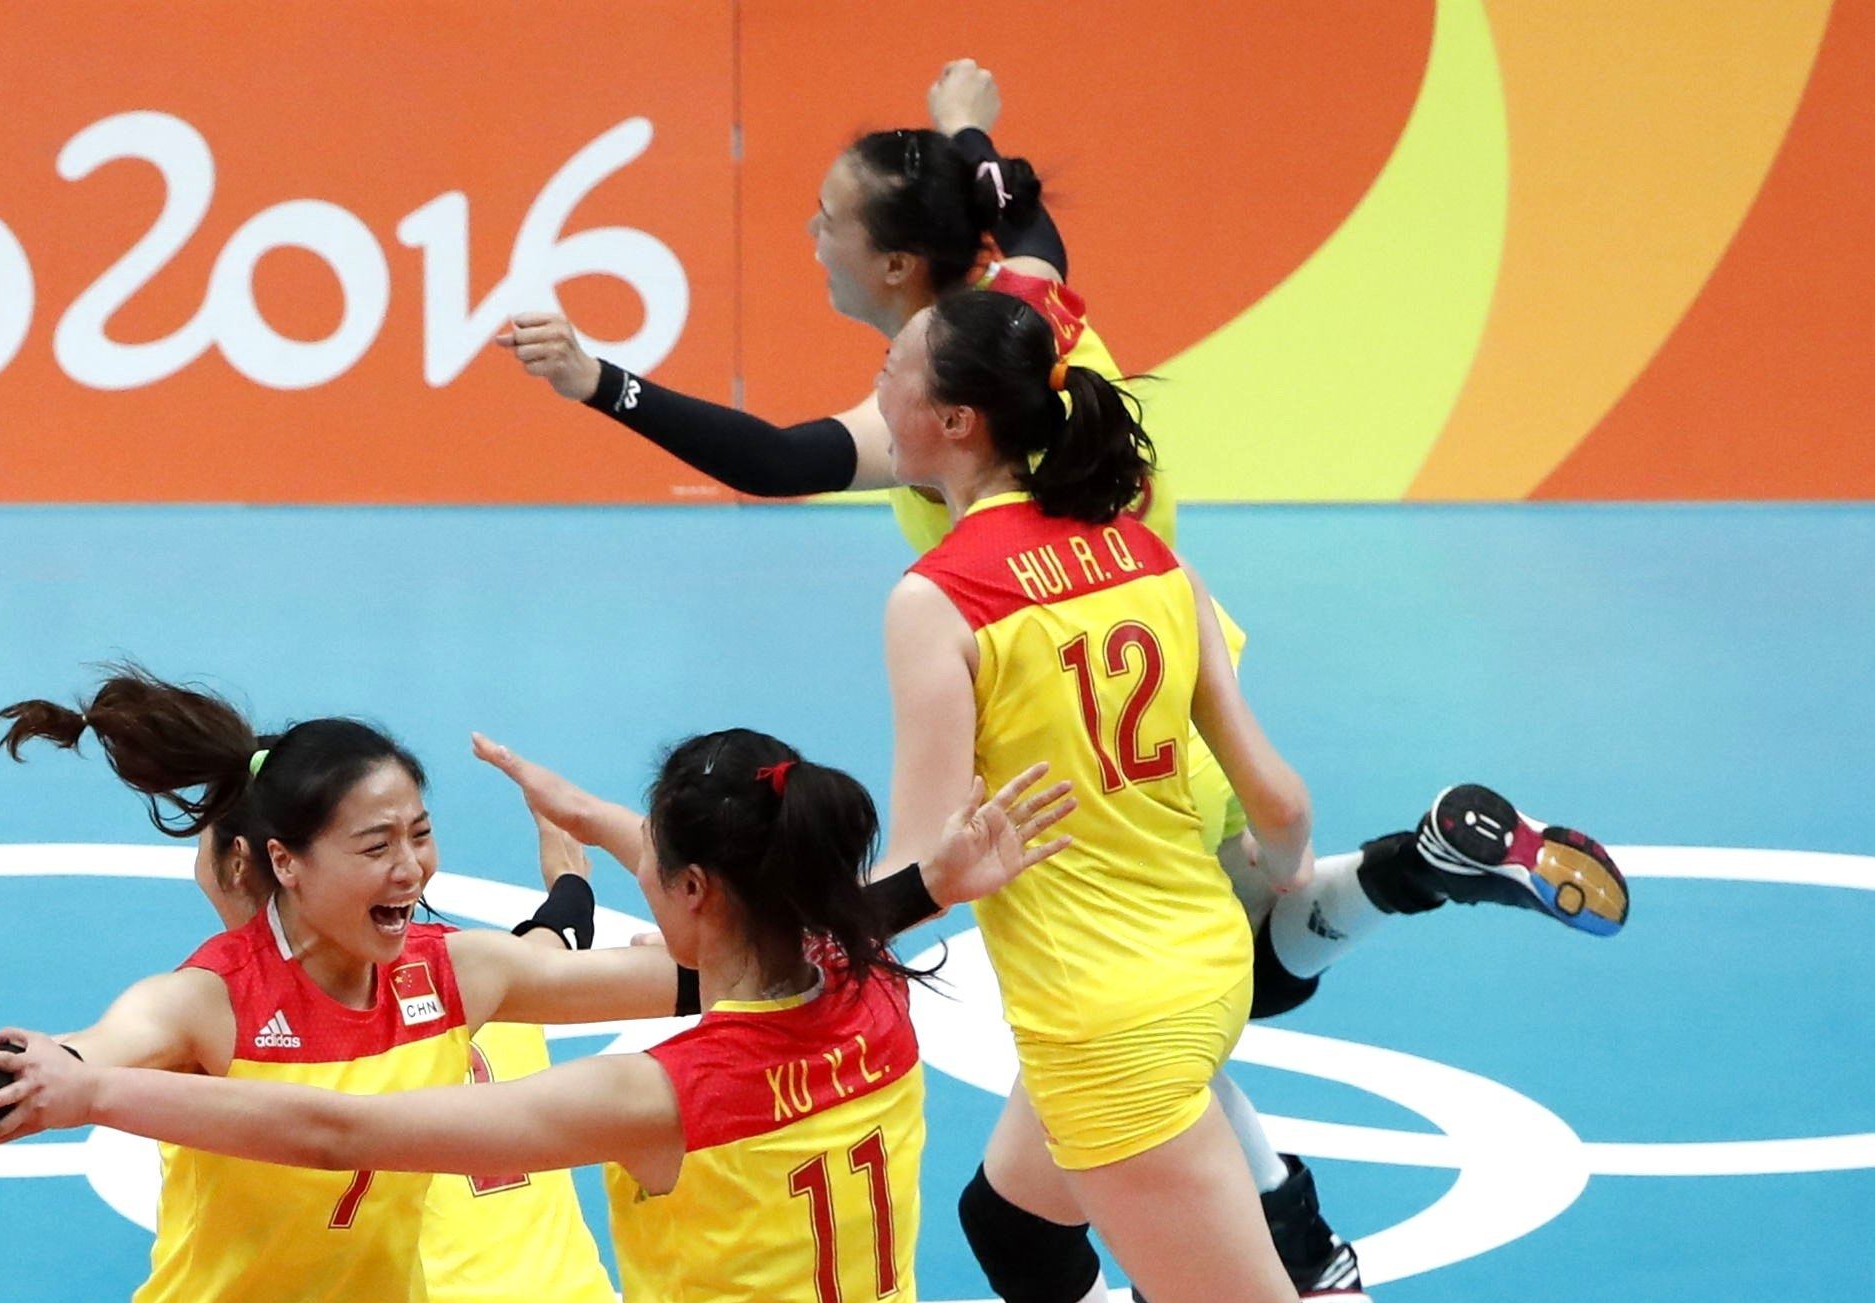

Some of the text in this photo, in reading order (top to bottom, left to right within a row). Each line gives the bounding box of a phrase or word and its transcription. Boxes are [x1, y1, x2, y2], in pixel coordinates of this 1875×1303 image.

[1006, 526, 1144, 600] HUI R. Q.
[1058, 619, 1178, 795] 12
[254, 1030, 301, 1048] adidas
[406, 1000, 439, 1018] CHN
[765, 1058, 814, 1122] XU
